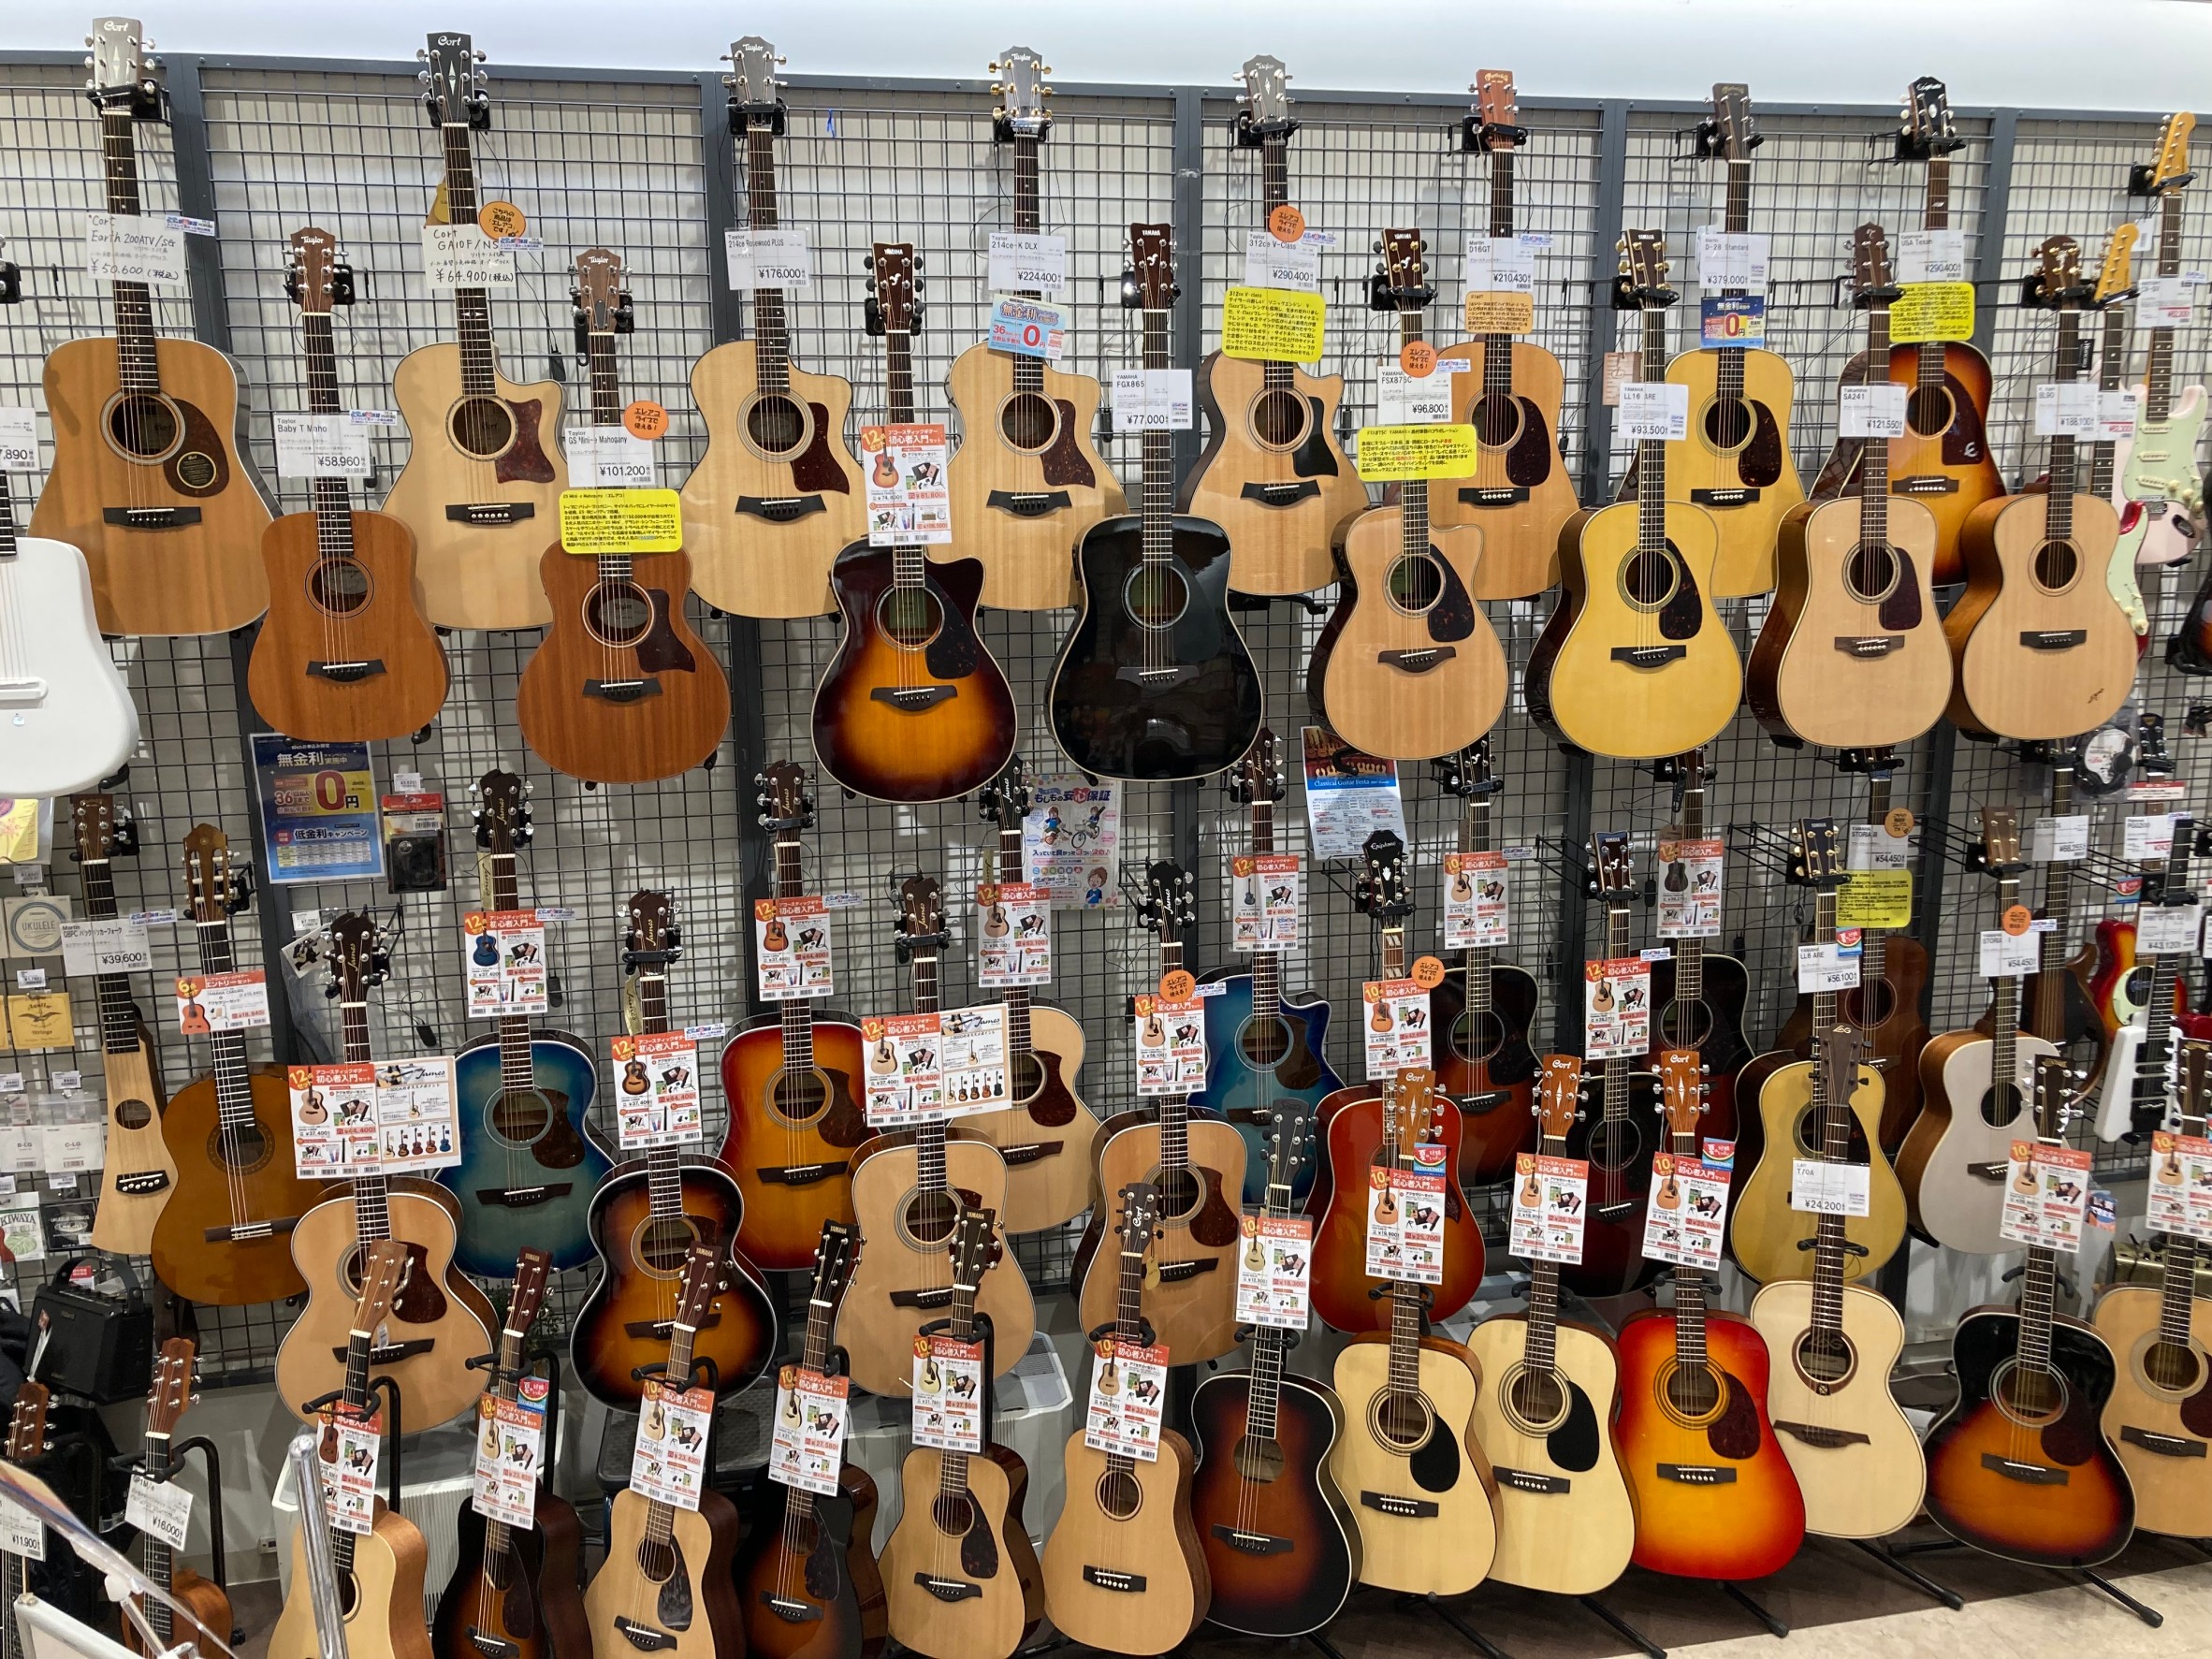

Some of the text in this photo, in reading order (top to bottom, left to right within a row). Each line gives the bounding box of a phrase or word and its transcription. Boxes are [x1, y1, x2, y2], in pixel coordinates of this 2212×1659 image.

[103, 21, 129, 32] Cort
[437, 36, 461, 46] Cort
[742, 43, 764, 52] Taylor
[1011, 53, 1031, 62] Taylor
[92, 215, 117, 226] Cort
[1278, 211, 1300, 223] エレアコ
[91, 229, 122, 242] Earth
[433, 229, 458, 239] Cort
[301, 236, 324, 244] Taylor
[1249, 240, 1297, 250] 312ce V-Class
[588, 256, 609, 265] Taylor
[759, 269, 801, 279] ¥176,000
[1018, 271, 1057, 283] ¥224,400
[1273, 269, 1310, 282] ¥290,400
[1493, 272, 1528, 284] ¥210,430
[1707, 275, 1745, 284] ¥379,000
[1409, 348, 1431, 357] エレアコ
[634, 407, 661, 417] エレアコ
[1412, 404, 1445, 414] ¥96,800
[634, 415, 659, 424] ライブで
[1127, 415, 1165, 425] ¥77,000
[277, 425, 298, 433] Baby
[1631, 425, 1665, 435] ¥93,500
[599, 436, 627, 445] Mahogany
[318, 456, 360, 467] ¥58,960
[600, 466, 646, 477] ¥101,200
[277, 750, 324, 767] 無金利
[274, 791, 293, 806] 36
[294, 828, 369, 841] 低金利キャンペーン
[1875, 854, 1902, 863] ¥54,450
[22, 921, 55, 931] UKULELE
[102, 953, 142, 965] ¥39,600
[1167, 975, 1187, 985] エレアコ
[1826, 973, 1854, 982] ¥56,100
[1552, 1059, 1572, 1069] Cort
[1670, 1055, 1690, 1064] Cort
[316, 1074, 371, 1084] 初心者入門セット
[415, 1068, 445, 1080] James
[1405, 1071, 1425, 1082] Cort
[1392, 1178, 1442, 1190] 初心者入門セット
[1804, 1199, 1841, 1211] ¥24,200
[1132, 1206, 1143, 1228] Cort
[153, 1516, 180, 1539] ¥16,000
[12, 1534, 38, 1549] ¥11,900
